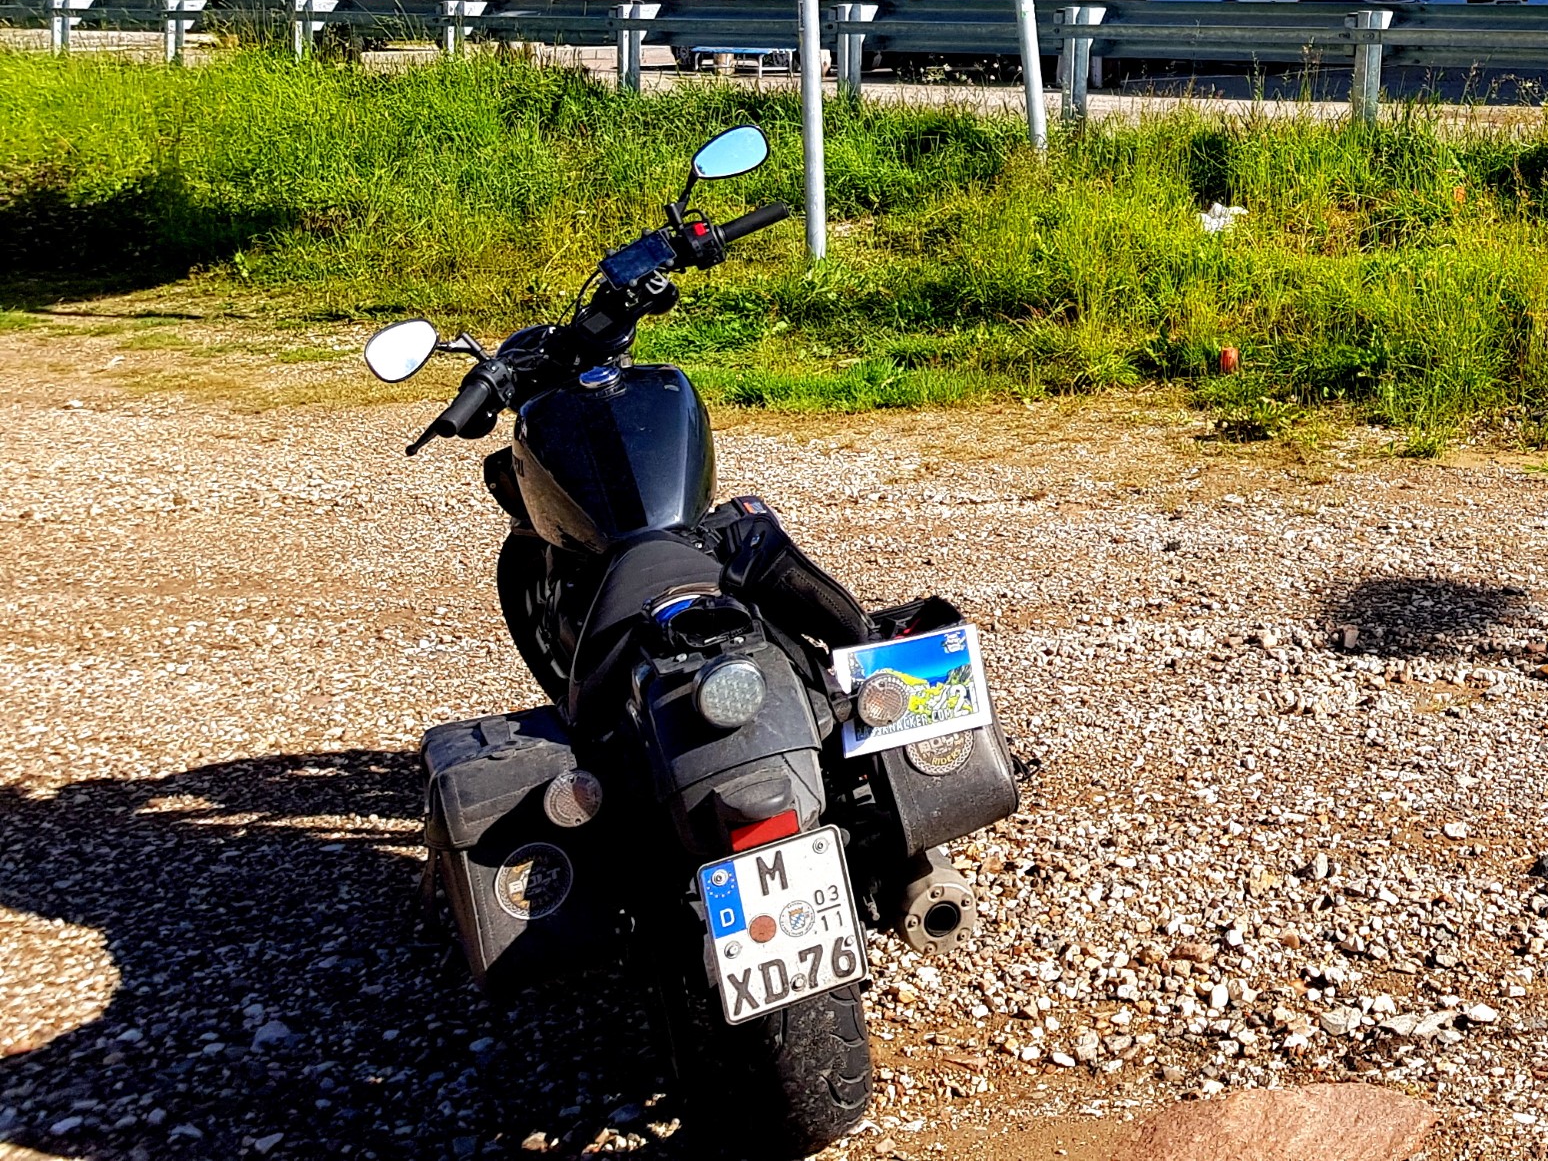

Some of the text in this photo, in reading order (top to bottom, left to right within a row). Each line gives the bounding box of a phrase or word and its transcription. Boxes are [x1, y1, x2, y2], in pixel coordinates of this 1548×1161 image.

[755, 849, 789, 897] M
[814, 884, 840, 906] 03
[719, 907, 735, 928] D
[820, 910, 843, 932] 11
[727, 936, 857, 1017] XD 76
